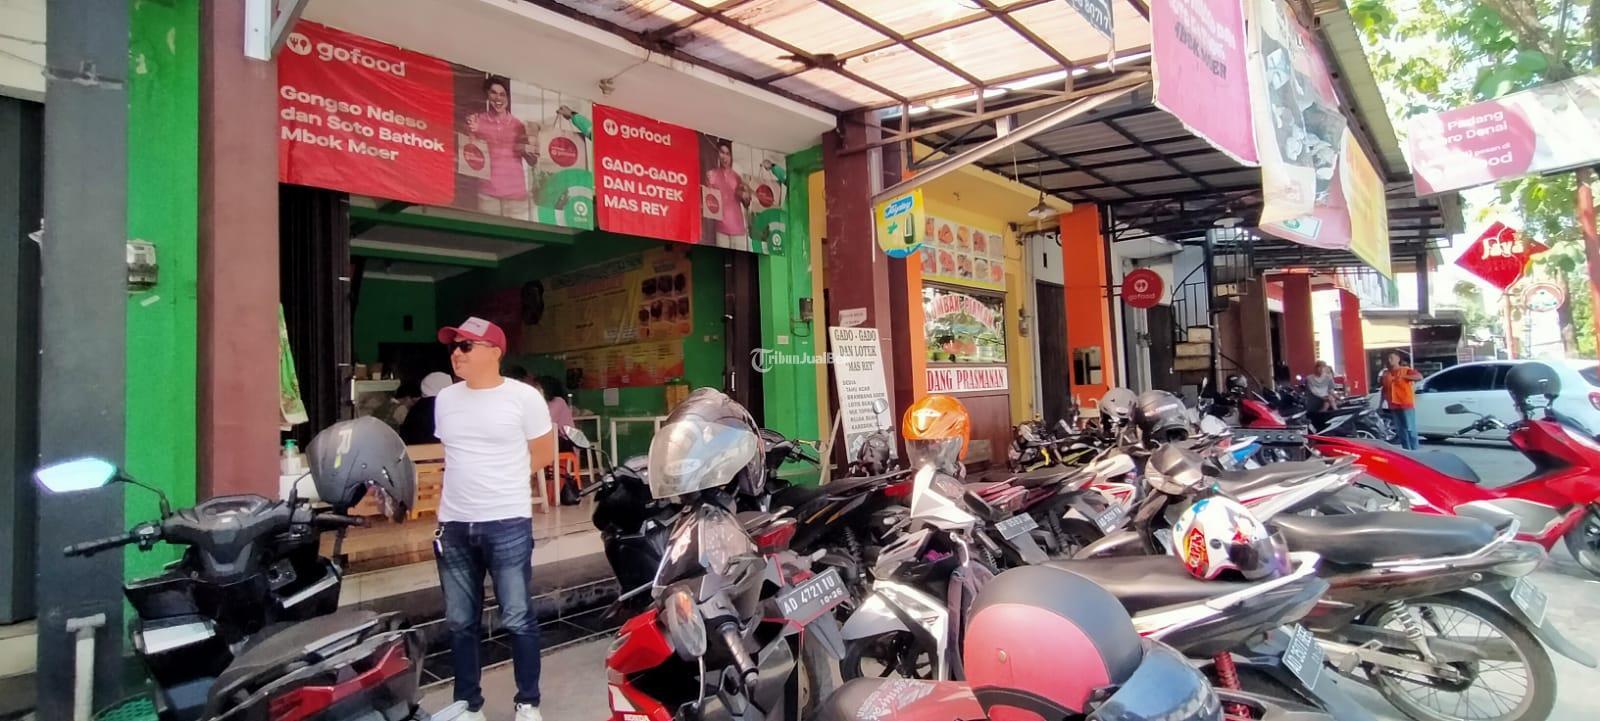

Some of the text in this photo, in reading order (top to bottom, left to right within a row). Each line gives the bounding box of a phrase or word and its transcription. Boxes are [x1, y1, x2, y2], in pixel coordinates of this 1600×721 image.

[317, 41, 406, 76] gofood
[280, 85, 427, 130] Gongso Ndeso
[281, 107, 445, 152] dan Soto Bathok
[1447, 111, 1504, 132] Padang
[281, 126, 398, 161] Mbok Moer
[620, 124, 671, 146] gofood
[602, 156, 687, 185] GADO-GADO
[603, 176, 684, 202] DAN LOTEK
[604, 195, 669, 217] MAS REY
[834, 329, 853, 341] GADO
[859, 330, 876, 341] GADO
[839, 346, 877, 357] DAN LOTEK
[956, 369, 1004, 390] PRASMANAN
[783, 597, 798, 614] AD
[800, 582, 823, 603] 4721
